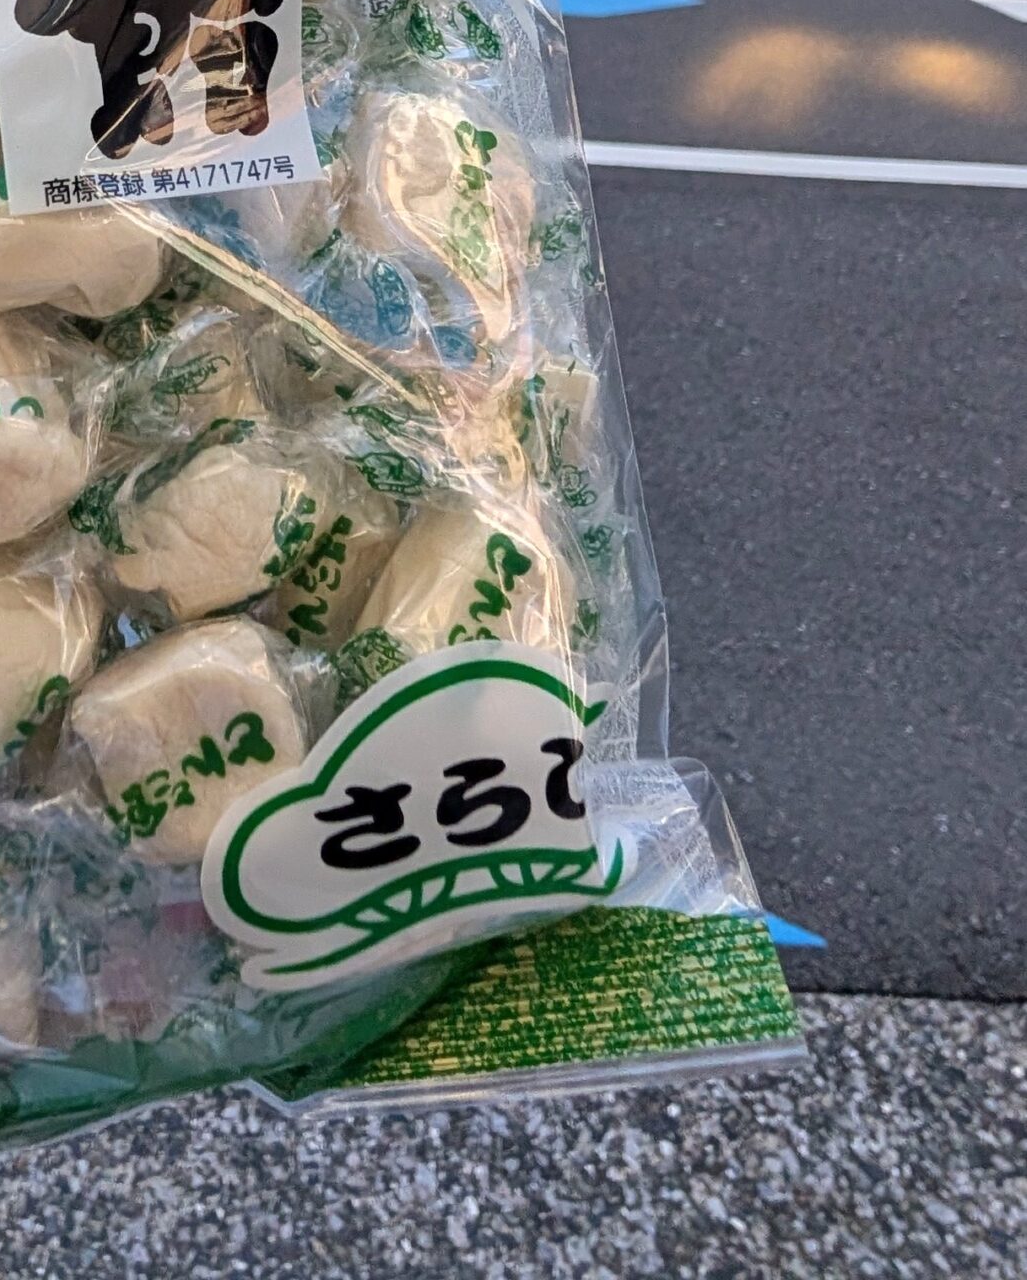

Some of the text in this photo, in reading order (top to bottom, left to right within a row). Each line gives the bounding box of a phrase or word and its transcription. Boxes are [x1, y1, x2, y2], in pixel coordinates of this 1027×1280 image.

[42, 170, 147, 208] 商標登録
[153, 154, 296, 194] 第4171747号
